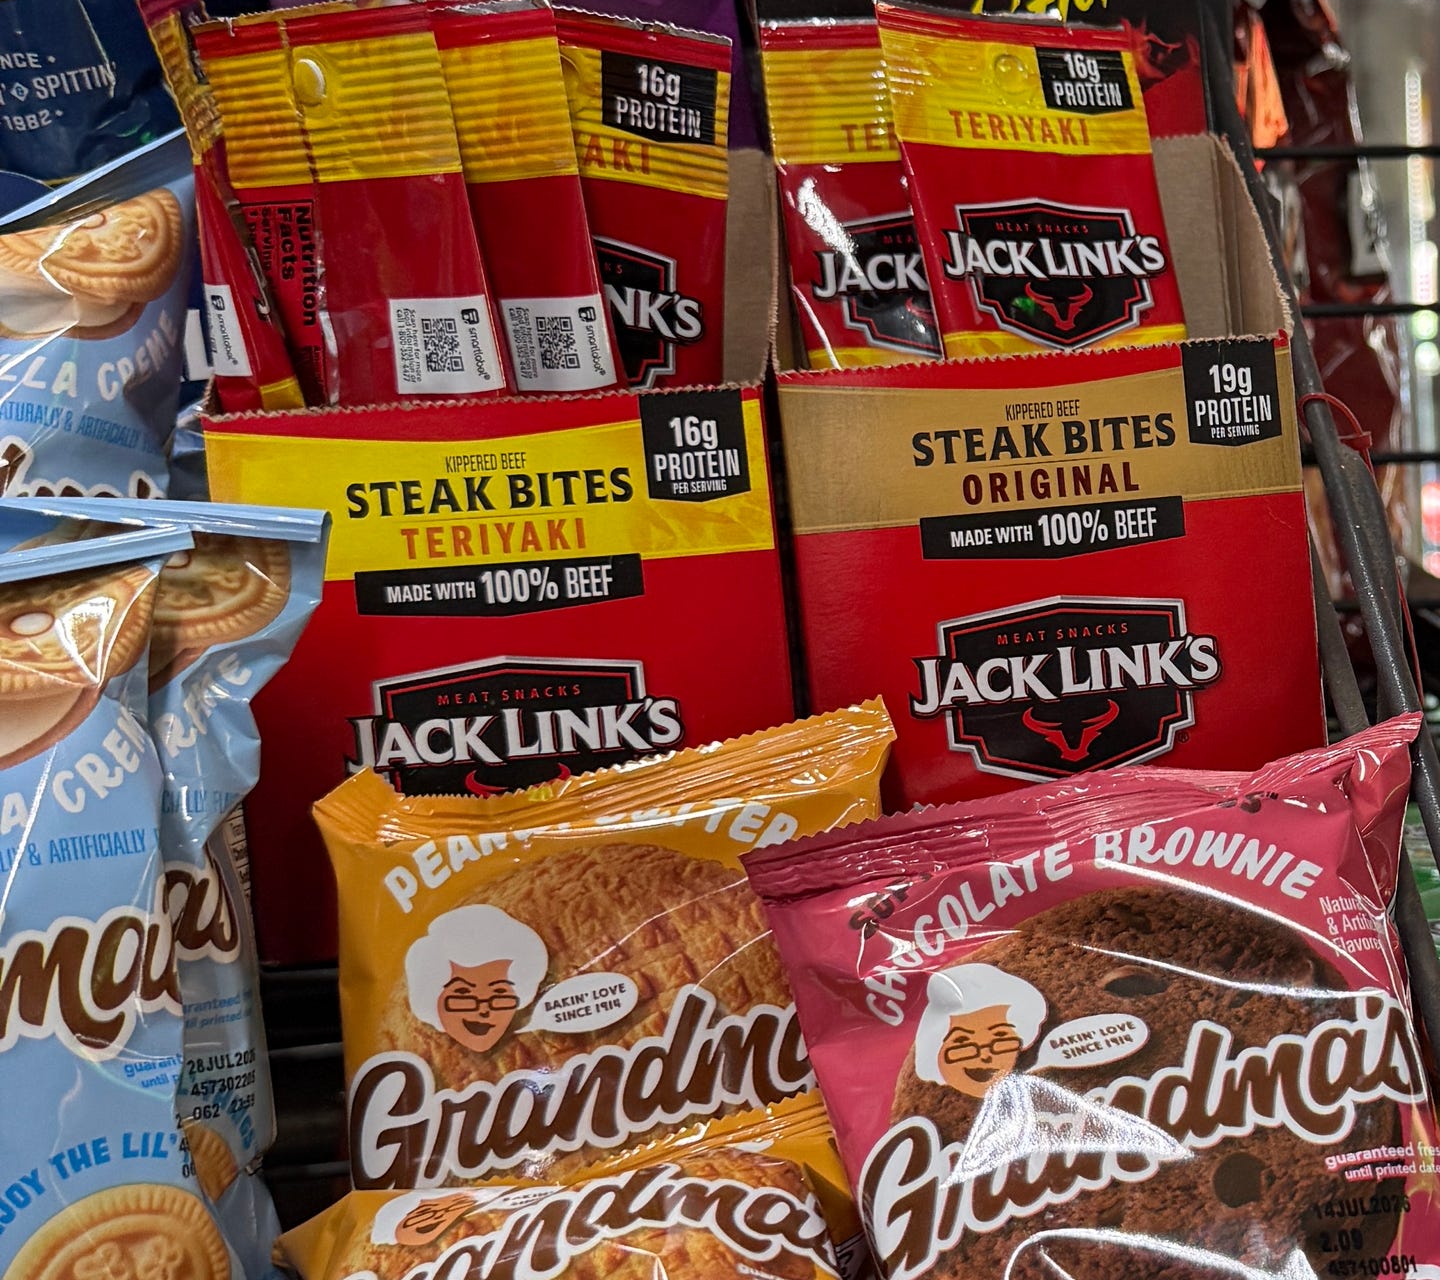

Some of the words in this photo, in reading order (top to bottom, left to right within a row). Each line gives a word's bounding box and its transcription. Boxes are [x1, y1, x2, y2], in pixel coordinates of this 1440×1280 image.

[1063, 51, 1099, 82] 16g
[637, 63, 683, 108] 16g
[1053, 80, 1122, 108] PROTEIN
[613, 96, 703, 139] PROTEIN
[948, 109, 1091, 147] TERIYAKI
[277, 206, 298, 280] Facts
[943, 229, 1046, 278] JACK
[1044, 234, 1167, 278] LINK'S
[294, 205, 317, 327] Nutrition
[813, 250, 927, 299] JACK
[1207, 363, 1253, 396] 19g
[1005, 401, 1054, 421] KIPPERED
[1056, 398, 1081, 418] BEEF
[1194, 393, 1273, 428] PROTEIN
[668, 415, 719, 449] 16g
[912, 423, 1051, 467] STEAK
[1063, 412, 1177, 455] BITES
[1210, 426, 1224, 439] PER
[1225, 423, 1260, 438] SERVING
[444, 453, 498, 474] KIPPERED
[499, 451, 527, 472] BEEF
[654, 448, 741, 482] PROTEIN
[346, 476, 492, 520] STEAK
[508, 467, 634, 510] BITES
[672, 481, 689, 494] PER
[690, 478, 728, 493] SERVING
[962, 461, 1140, 506] ORIGINAL
[400, 517, 588, 561] TERIYAKI
[950, 528, 993, 548] MADE
[994, 524, 1034, 543] WITH
[1037, 512, 1110, 548] 100%
[1114, 506, 1158, 541] BEEF
[386, 583, 434, 604] MADE
[434, 580, 477, 601] WITH
[479, 566, 559, 605] 100%
[565, 564, 613, 599] BEEF
[997, 630, 1046, 645] MEAT
[1056, 622, 1130, 639] SNACKS
[911, 654, 1060, 715] JACK
[1057, 638, 1221, 698] LINK'S
[437, 691, 491, 706] MEAT
[500, 684, 583, 702] SNACKS
[345, 716, 500, 776] JACK
[498, 697, 684, 766] LINK'S
[49, 828, 147, 865] ARTIFICIALLY
[383, 820, 574, 913] PEAN
[865, 841, 1074, 1027] CHOCOLATE
[1094, 825, 1324, 900] BROWNIE
[1326, 916, 1339, 936] &
[543, 992, 589, 1015] BAKIN'
[591, 982, 627, 1003] LOVE
[554, 1005, 592, 1024] SINCE
[594, 998, 623, 1017] 1914
[1050, 1030, 1097, 1050] BAKIN'
[1099, 1021, 1137, 1040] LOVE
[1062, 1042, 1102, 1061] SINCE
[1103, 1032, 1134, 1050] 1914
[48, 1136, 111, 1180] THE
[122, 1131, 178, 1159] LIL'
[1324, 1142, 1415, 1170] guaranteed
[1344, 1163, 1373, 1181] until
[1375, 1161, 1416, 1182] printed
